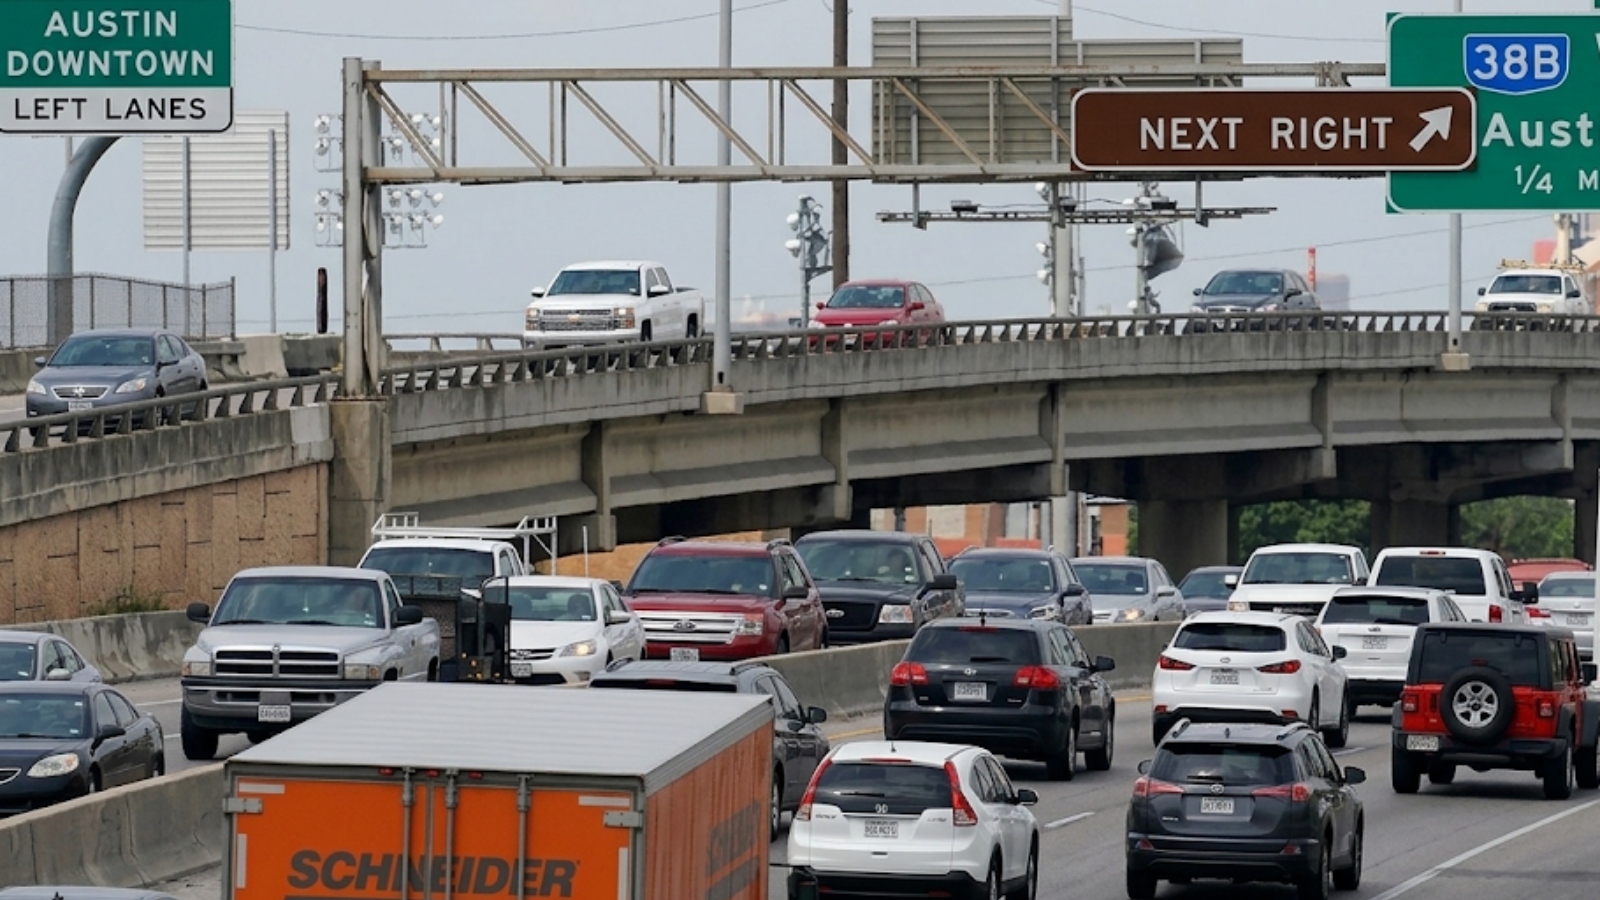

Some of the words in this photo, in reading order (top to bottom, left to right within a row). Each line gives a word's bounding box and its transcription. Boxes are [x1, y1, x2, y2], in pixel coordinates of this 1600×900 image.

[44, 10, 177, 38] AUSTIN
[7, 50, 214, 77] DOWNTOWN
[1473, 43, 1561, 81] 38B
[14, 98, 88, 120] LEFT
[105, 98, 207, 120] LANES
[1139, 117, 1244, 151] NEXT
[1270, 117, 1394, 151] RIGHT
[286, 849, 577, 898] SCHNEIDER
